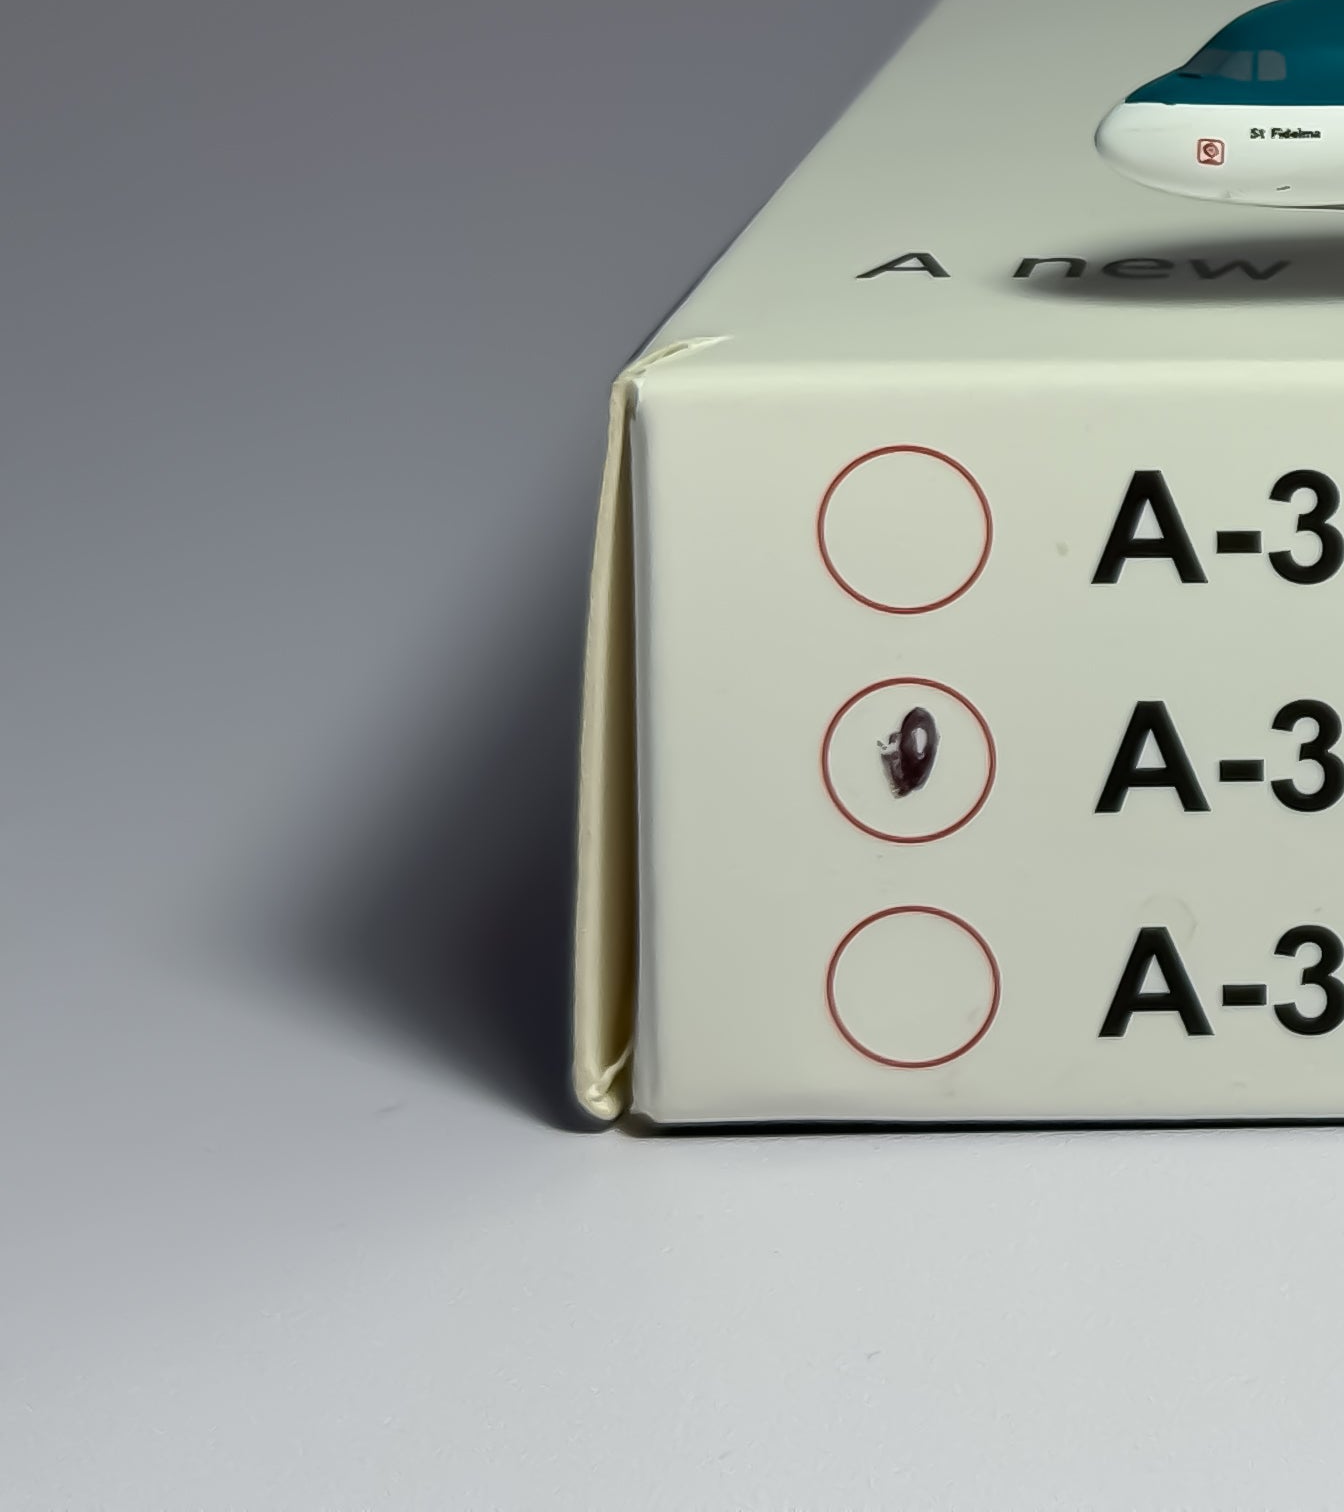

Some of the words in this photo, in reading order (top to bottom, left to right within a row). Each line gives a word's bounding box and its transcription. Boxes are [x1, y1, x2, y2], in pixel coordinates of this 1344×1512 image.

[1250, 127, 1266, 139] St
[855, 252, 951, 279] A
[1012, 256, 1291, 280] new
